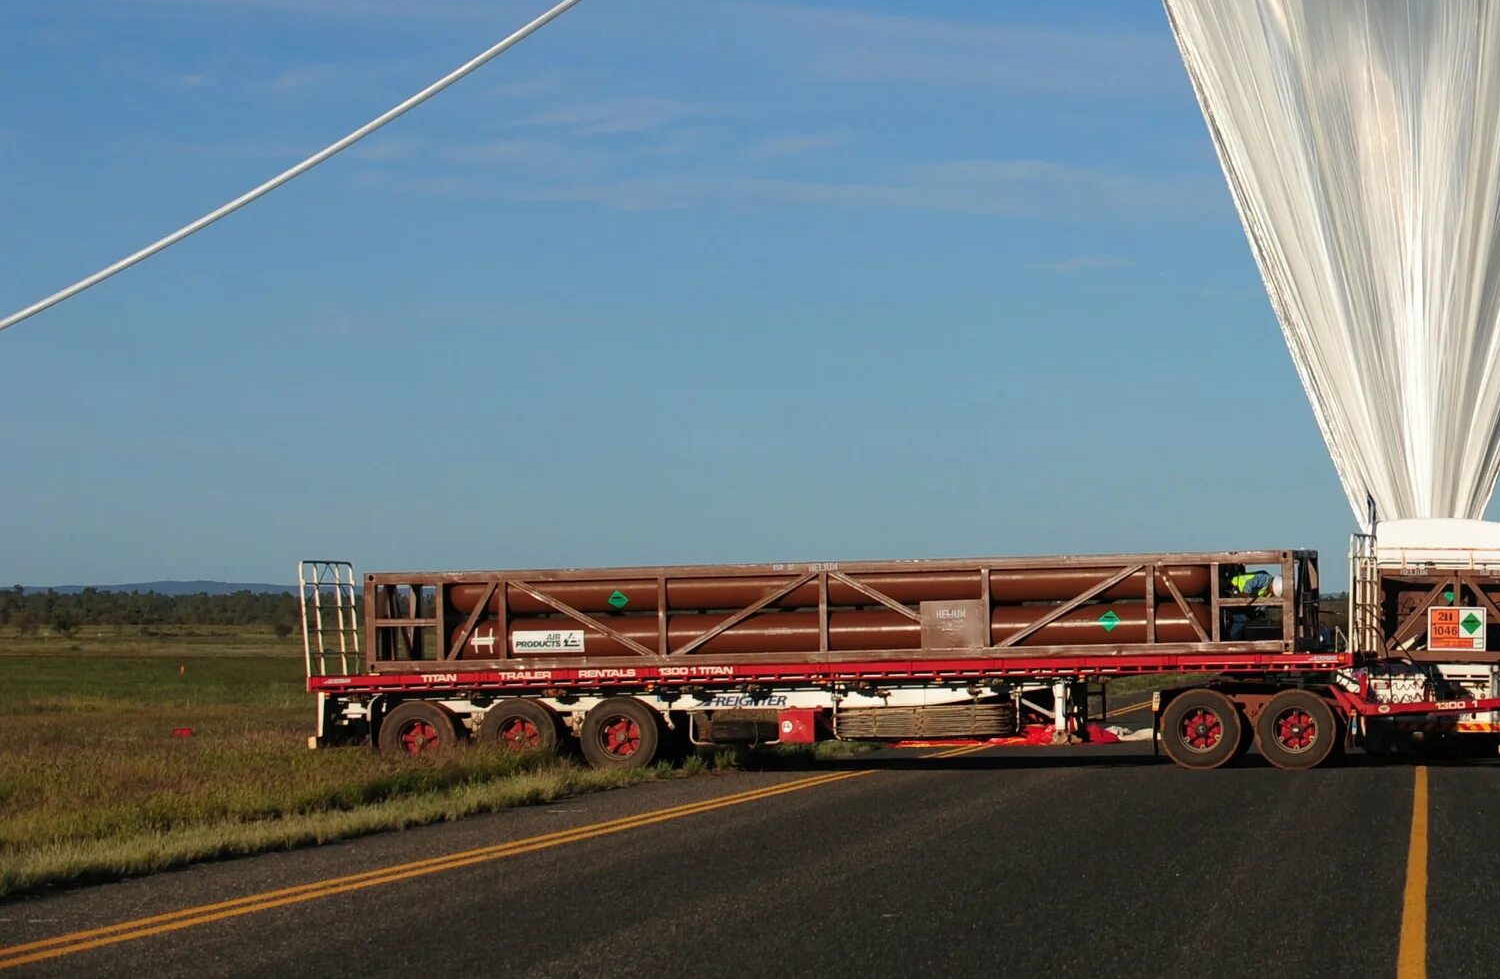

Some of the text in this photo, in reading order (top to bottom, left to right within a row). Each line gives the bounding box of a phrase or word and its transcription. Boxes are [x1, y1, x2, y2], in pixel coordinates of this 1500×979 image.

[1433, 625, 1458, 636] 1046
[515, 640, 561, 648] PRODUCTS
[420, 666, 734, 683] TITAN TRAILER RENTALS 1300 1 TITAN
[1435, 701, 1466, 710] 1300
[1471, 700, 1478, 708] 1
